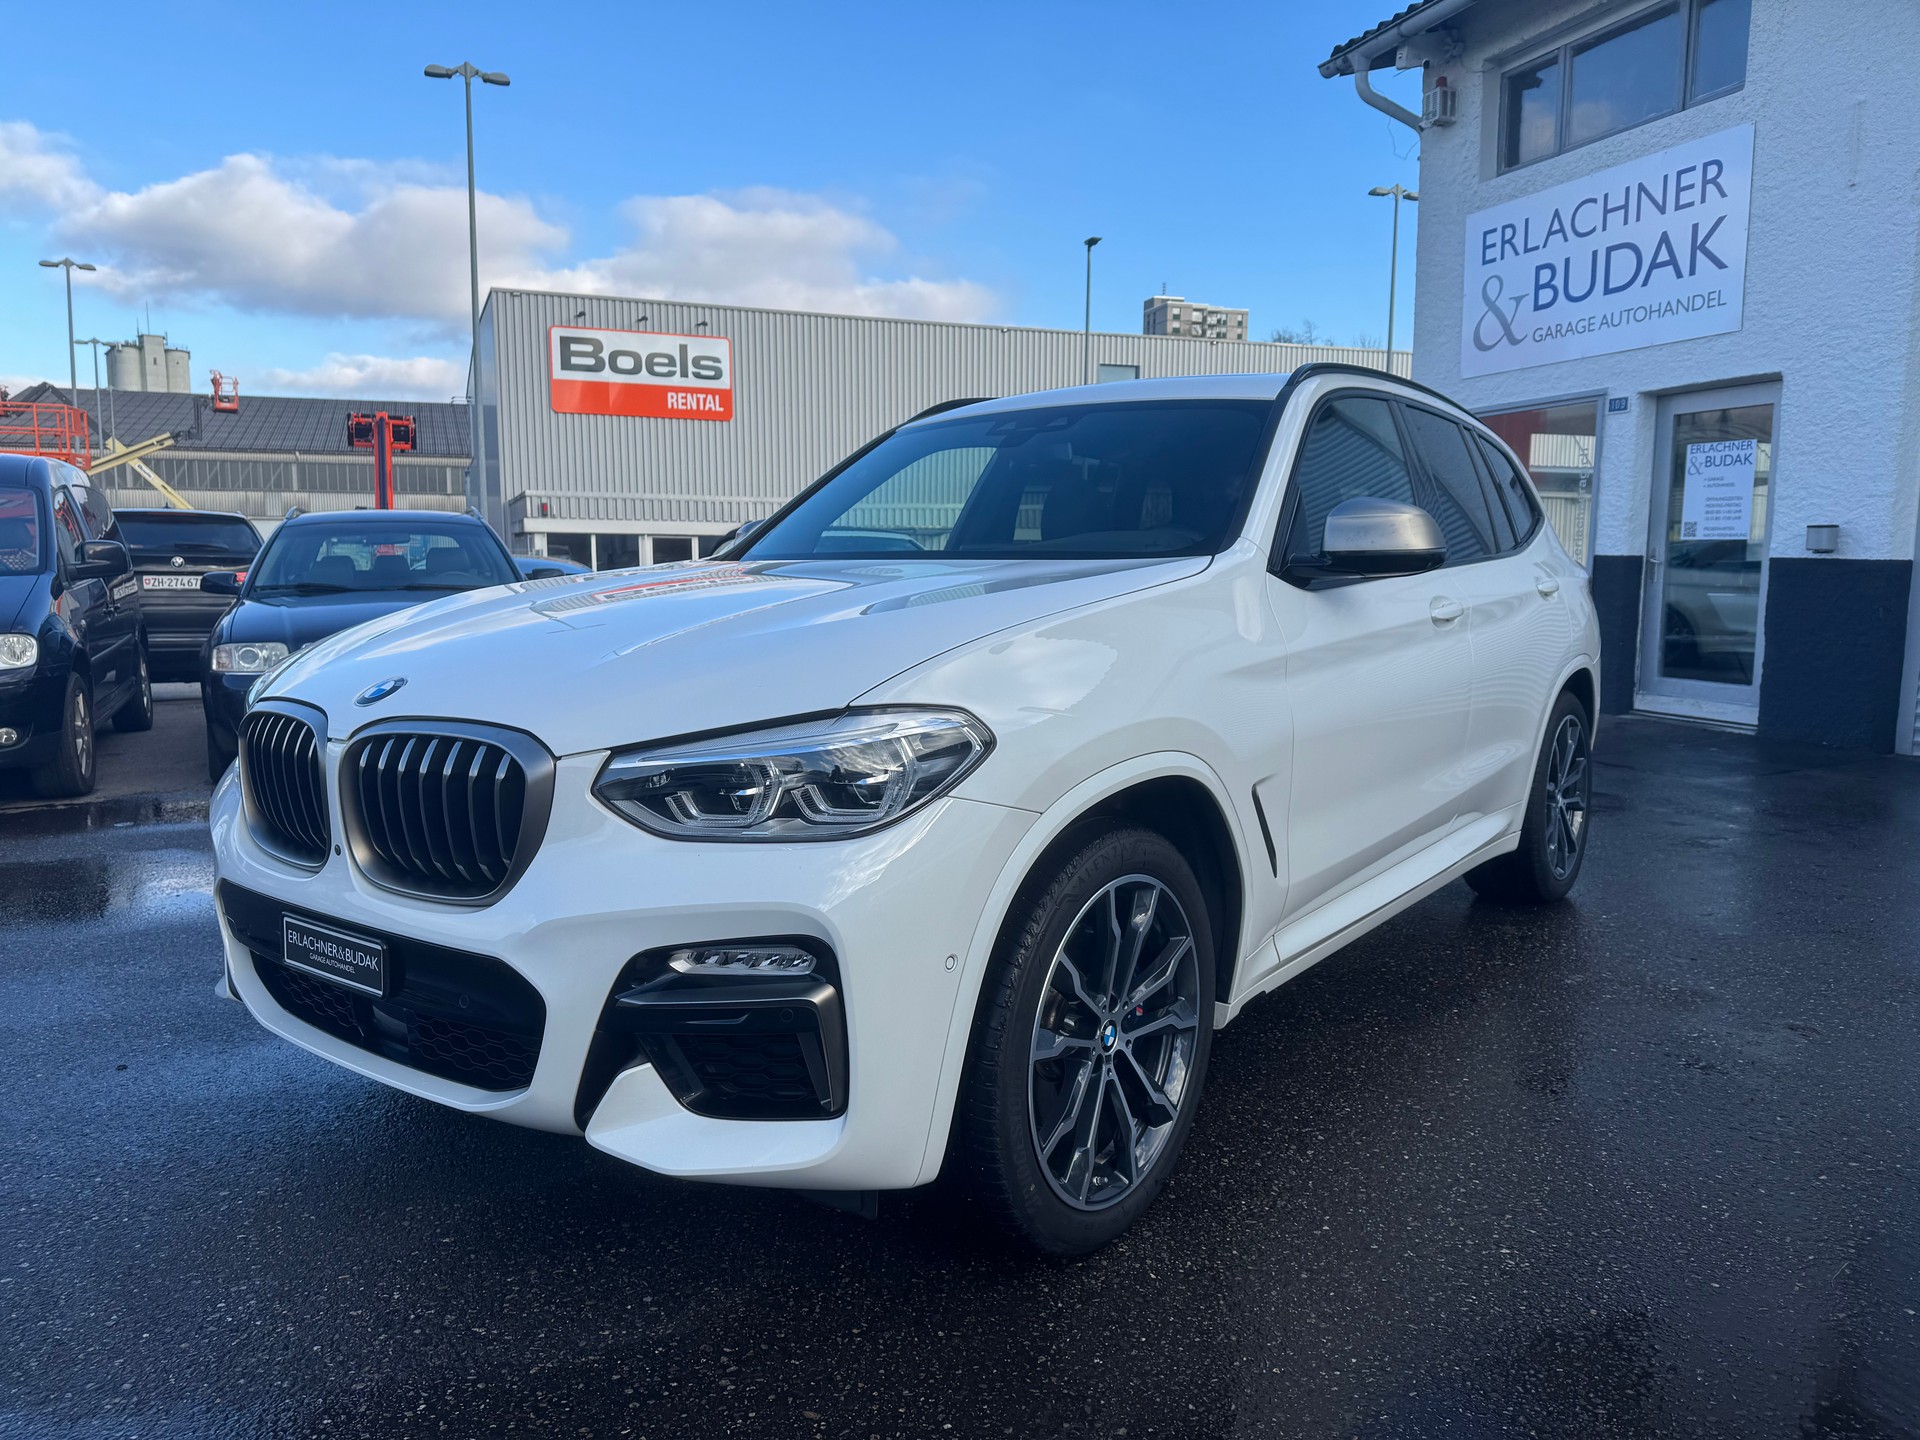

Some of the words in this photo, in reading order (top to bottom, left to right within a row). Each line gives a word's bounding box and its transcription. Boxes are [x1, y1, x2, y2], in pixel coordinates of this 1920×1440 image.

[1481, 159, 1728, 266] ERLACHNER
[1473, 274, 1530, 352] &
[1532, 214, 1729, 312] BUDAK
[1532, 316, 1596, 343] GARAGE
[1598, 289, 1727, 331] AUTOHANDEL
[559, 335, 723, 380] Boels
[667, 391, 724, 412] RENTAL
[1611, 398, 1626, 410] 109
[1690, 440, 1753, 454] ERLACHNER
[1688, 456, 1704, 475] &
[1704, 453, 1753, 468] BUDAK
[309, 952, 326, 964] GARAGE
[326, 958, 355, 974] AUTOHANDEL
